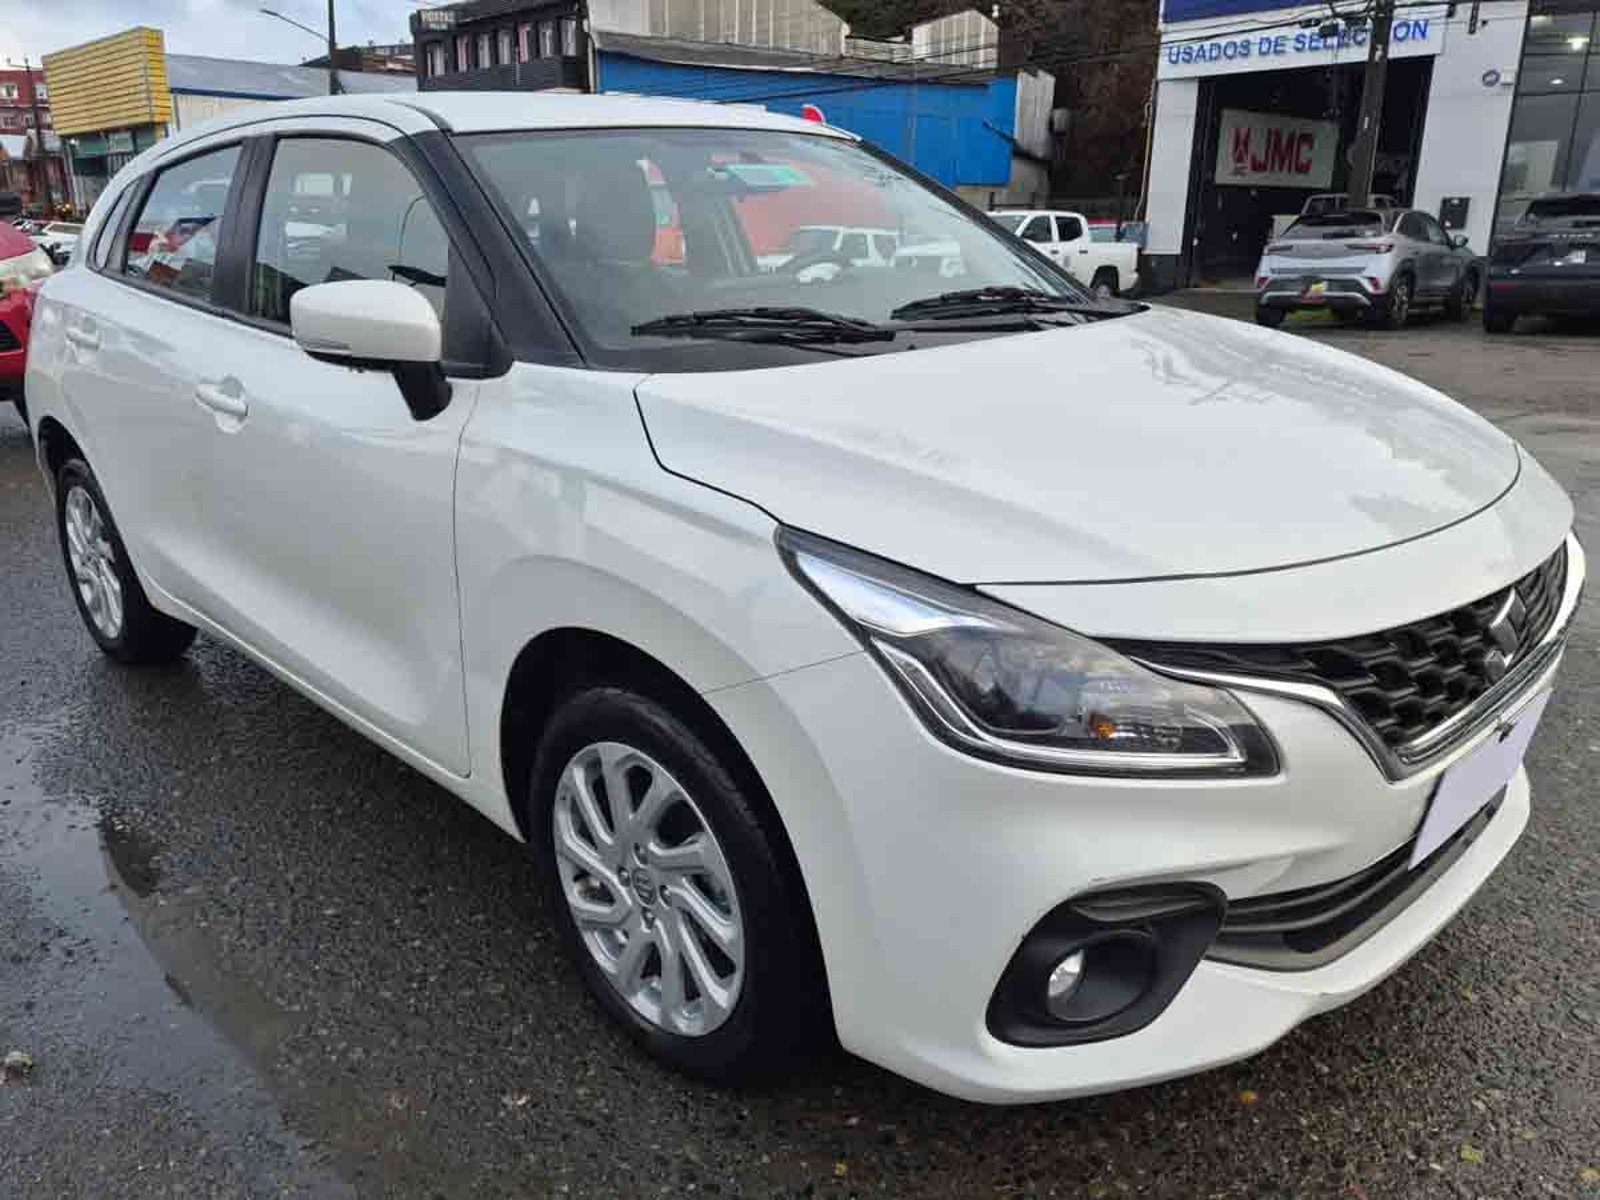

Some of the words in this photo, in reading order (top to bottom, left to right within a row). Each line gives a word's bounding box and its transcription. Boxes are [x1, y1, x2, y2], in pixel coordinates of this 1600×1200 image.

[1168, 39, 1250, 65] USADOS
[1258, 35, 1286, 56] DE
[1250, 127, 1315, 174] JMC
